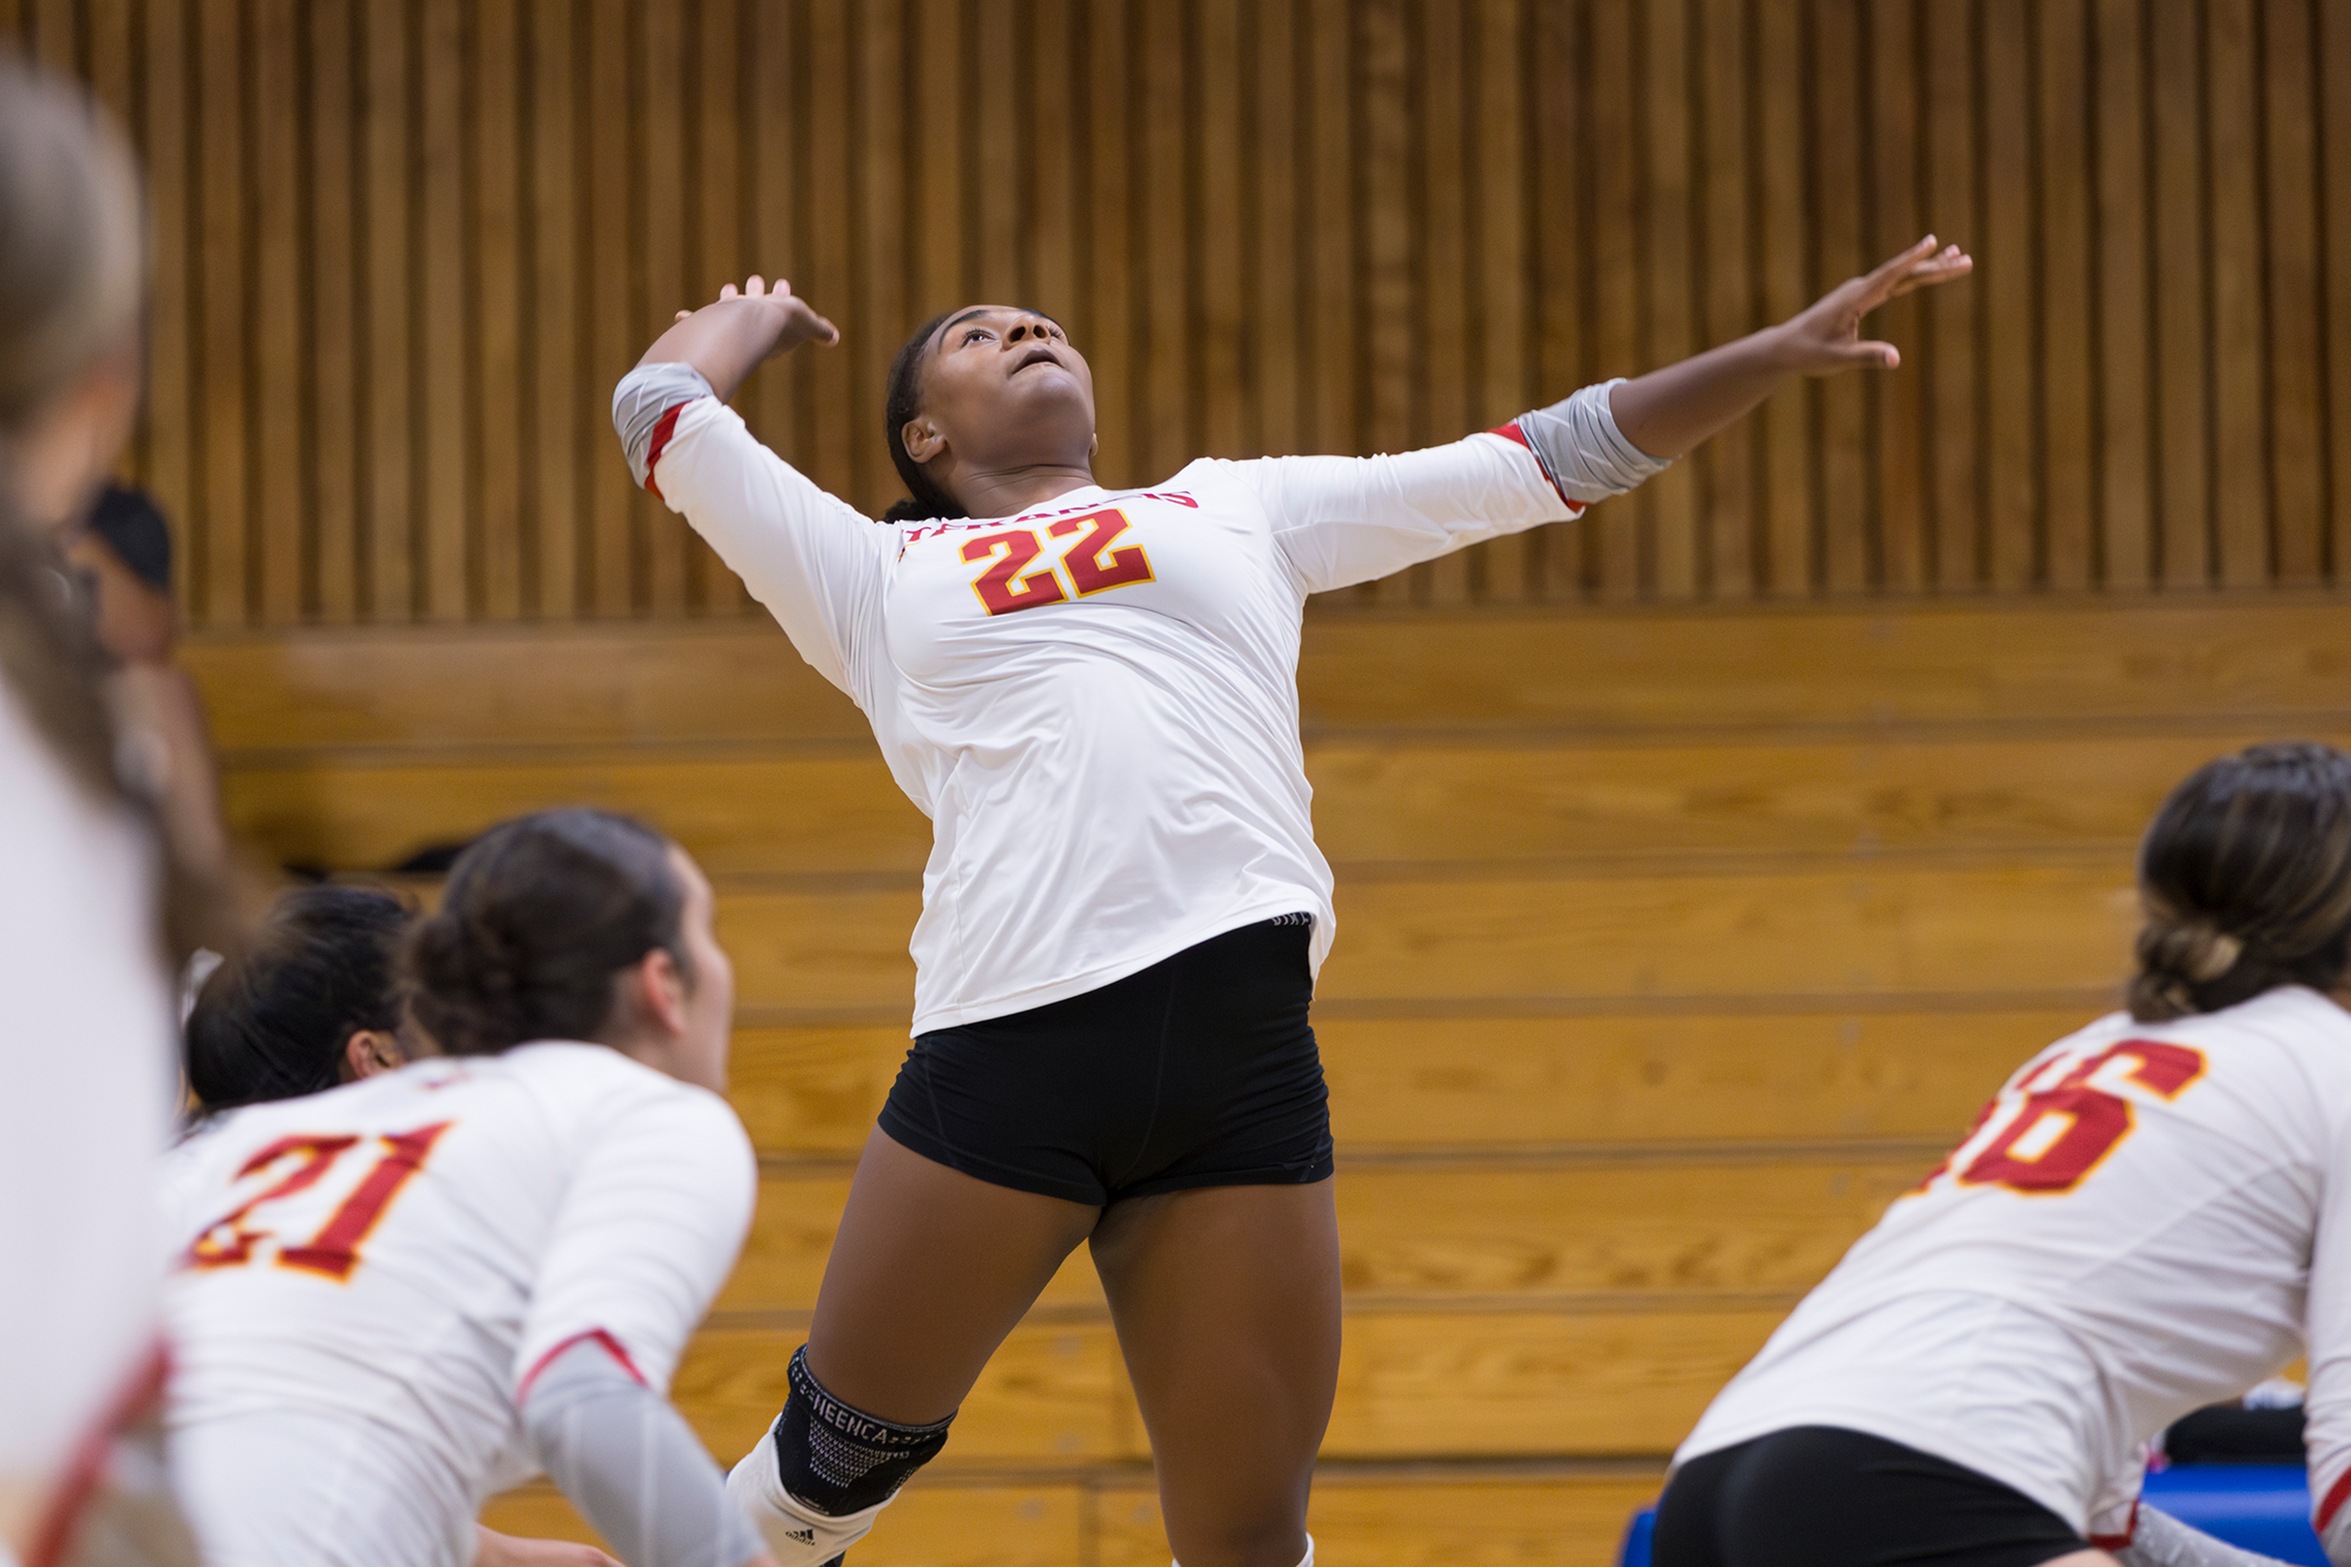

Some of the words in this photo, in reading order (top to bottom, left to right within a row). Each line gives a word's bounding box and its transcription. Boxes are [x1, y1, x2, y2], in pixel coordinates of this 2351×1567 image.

[959, 508, 1157, 617] 22
[168, 1119, 458, 1285] 21
[812, 1393, 888, 1445] NEENCA
